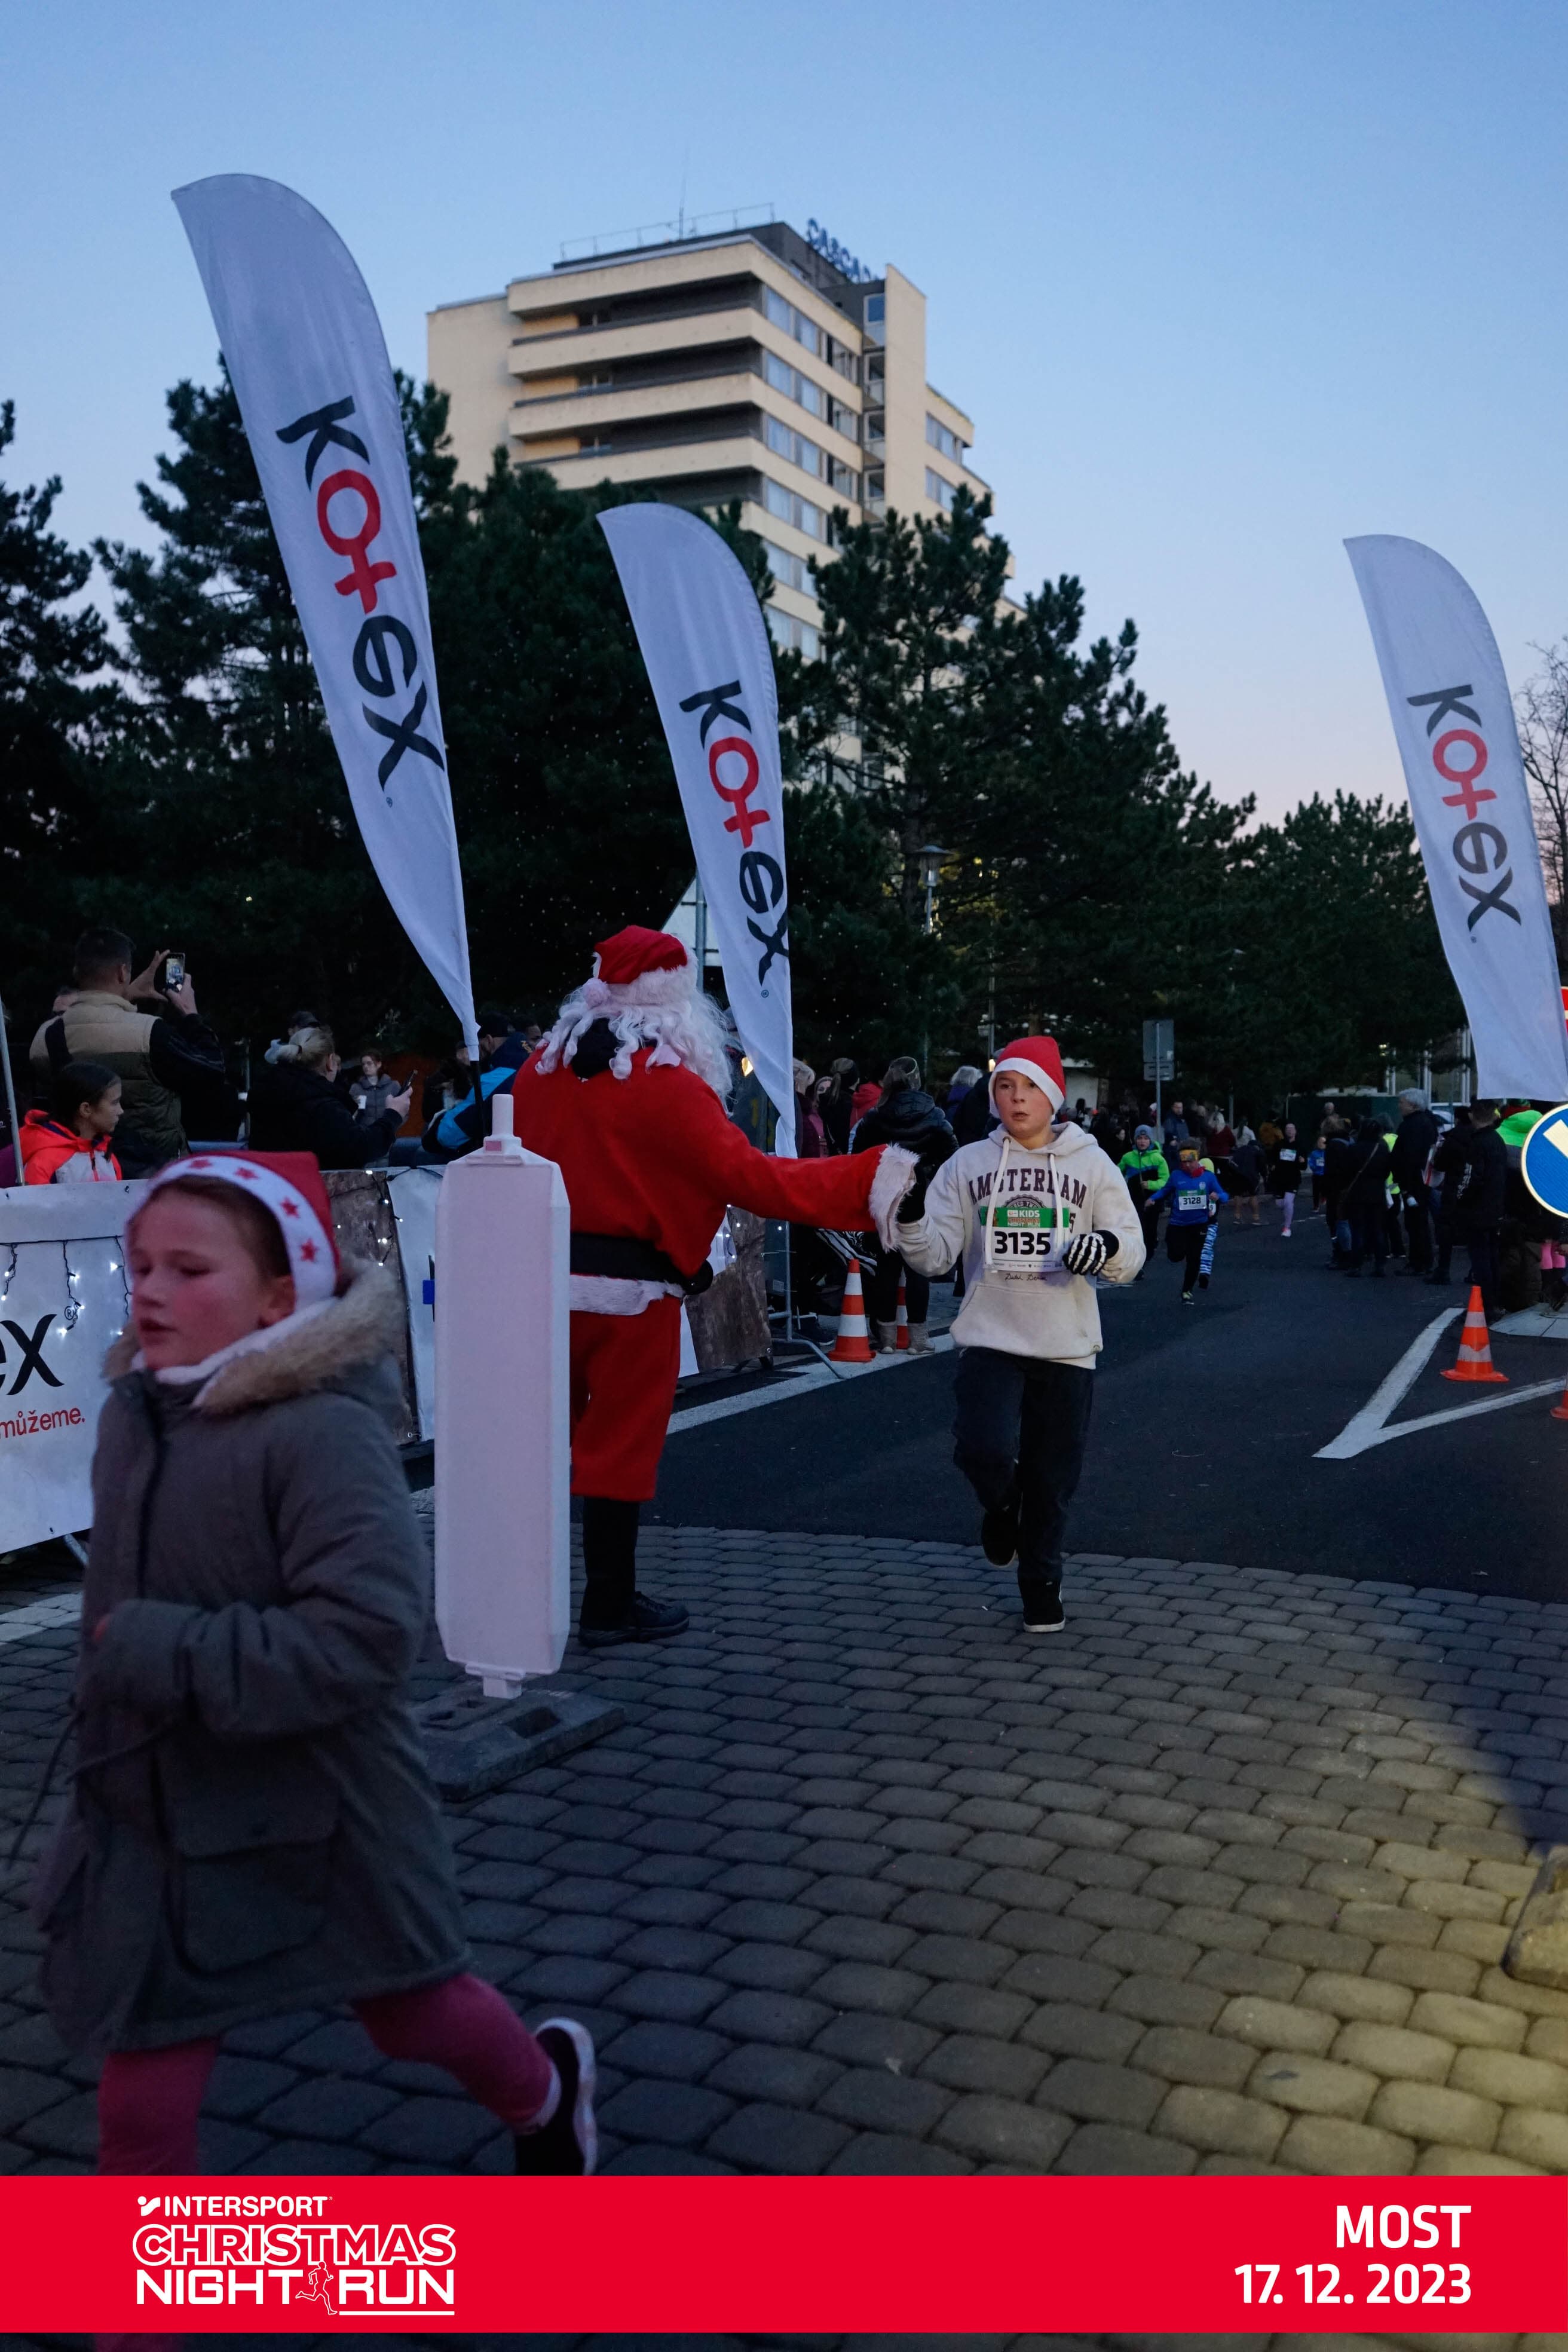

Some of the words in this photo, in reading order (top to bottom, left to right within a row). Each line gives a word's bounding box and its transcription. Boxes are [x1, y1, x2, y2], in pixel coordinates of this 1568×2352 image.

[994, 1231, 1051, 1255] 3135
[0, 1314, 65, 1395] x
[0, 1407, 85, 1439] můžeme.
